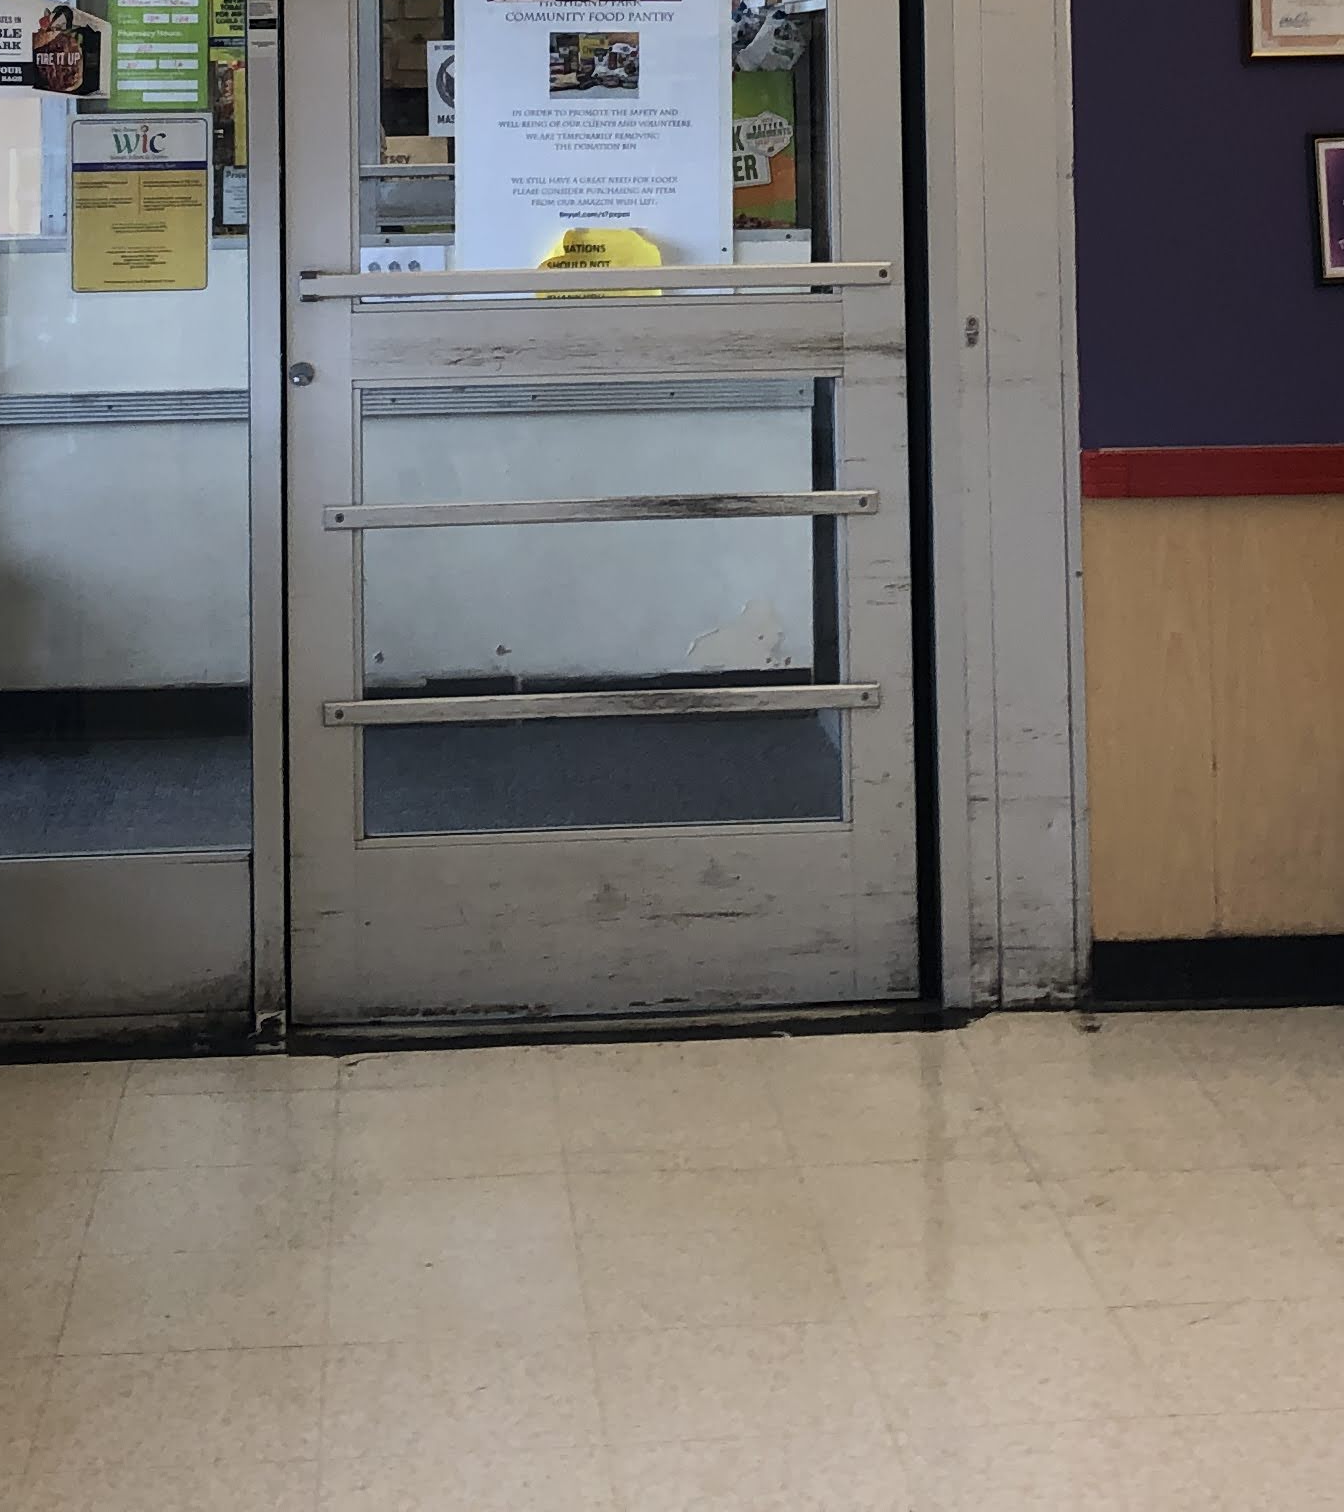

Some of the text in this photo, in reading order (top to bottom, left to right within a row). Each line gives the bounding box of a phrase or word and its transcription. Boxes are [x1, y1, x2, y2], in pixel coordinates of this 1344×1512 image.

[505, 11, 675, 22] COMMUNITY FOOD PANTRY
[67, 51, 82, 65] UP
